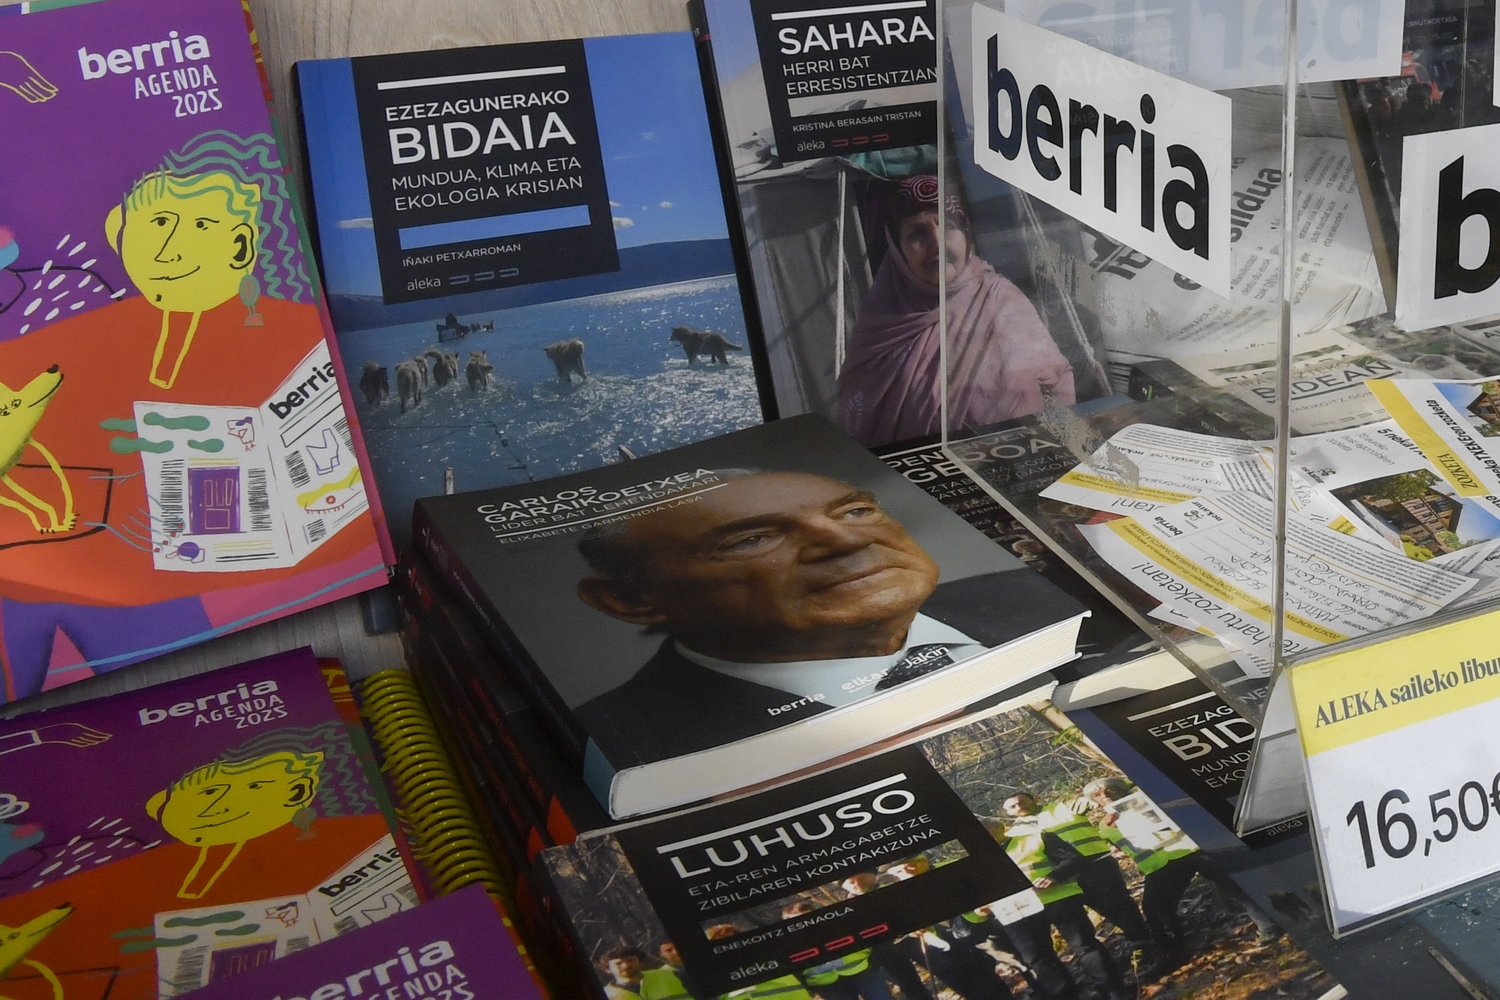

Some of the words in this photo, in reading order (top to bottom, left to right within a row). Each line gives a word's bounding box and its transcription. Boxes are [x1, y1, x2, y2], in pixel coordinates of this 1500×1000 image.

[778, 15, 936, 55] SAHARA
[77, 30, 211, 81] berria
[783, 59, 834, 77] HERRI
[839, 55, 871, 71] BAT
[134, 63, 218, 100] AGENDA
[786, 66, 939, 96] ERRESISTENTZIAN
[172, 88, 223, 118] 2025
[385, 89, 570, 123] EZEZAGUNERAKO
[792, 119, 836, 133] KRISTINA
[836, 114, 883, 129] BERASAIN
[884, 109, 922, 123] TRISTAN
[388, 111, 577, 165] BIDAIA
[797, 140, 826, 152] aleka
[986, 32, 1210, 261] berria
[391, 168, 481, 191] MUNDUA,
[485, 161, 543, 181] KLIMA
[547, 156, 582, 173] ETA
[395, 186, 500, 212] EKOLOGIA
[505, 175, 584, 198] KRISIAN
[402, 254, 434, 268] IÑAKI
[436, 243, 522, 264] PETXARROMAN
[407, 276, 442, 292] aleka
[268, 361, 337, 420] berria
[1436, 453, 1479, 490] ZOZKETA
[476, 485, 599, 516] CARLOS
[484, 467, 715, 526] GARAIKOETXEA
[490, 514, 545, 535] LIDER
[550, 507, 587, 524] BAT
[591, 474, 721, 516] LEHENDAKARI
[499, 525, 580, 546] ELIXABETE
[581, 501, 667, 532] GARMENDIA
[668, 494, 705, 511] LASA
[1153, 515, 1184, 537] berria
[1132, 561, 1223, 615] zozketan!
[1219, 611, 1270, 646] hartu
[767, 691, 826, 718] berria
[841, 667, 890, 694] elkar
[905, 644, 950, 670] Jakin
[1315, 687, 1389, 729] ALEKA
[1389, 668, 1460, 705] saileko
[138, 679, 280, 727] berria
[193, 693, 284, 728] AGENDA
[235, 705, 289, 730] 2025
[669, 788, 918, 881] LUHUSO
[1265, 817, 1304, 838] aleka
[317, 846, 402, 899] berria
[688, 862, 779, 898] ETA-REN
[784, 812, 933, 870] ARMAGABETZE
[698, 872, 802, 913] ZIBILAREN
[804, 827, 943, 879] KONTAKIZUNA
[712, 926, 785, 956] ENEKOITZ
[787, 903, 856, 932] ESNAOLA
[729, 958, 780, 983] aleka
